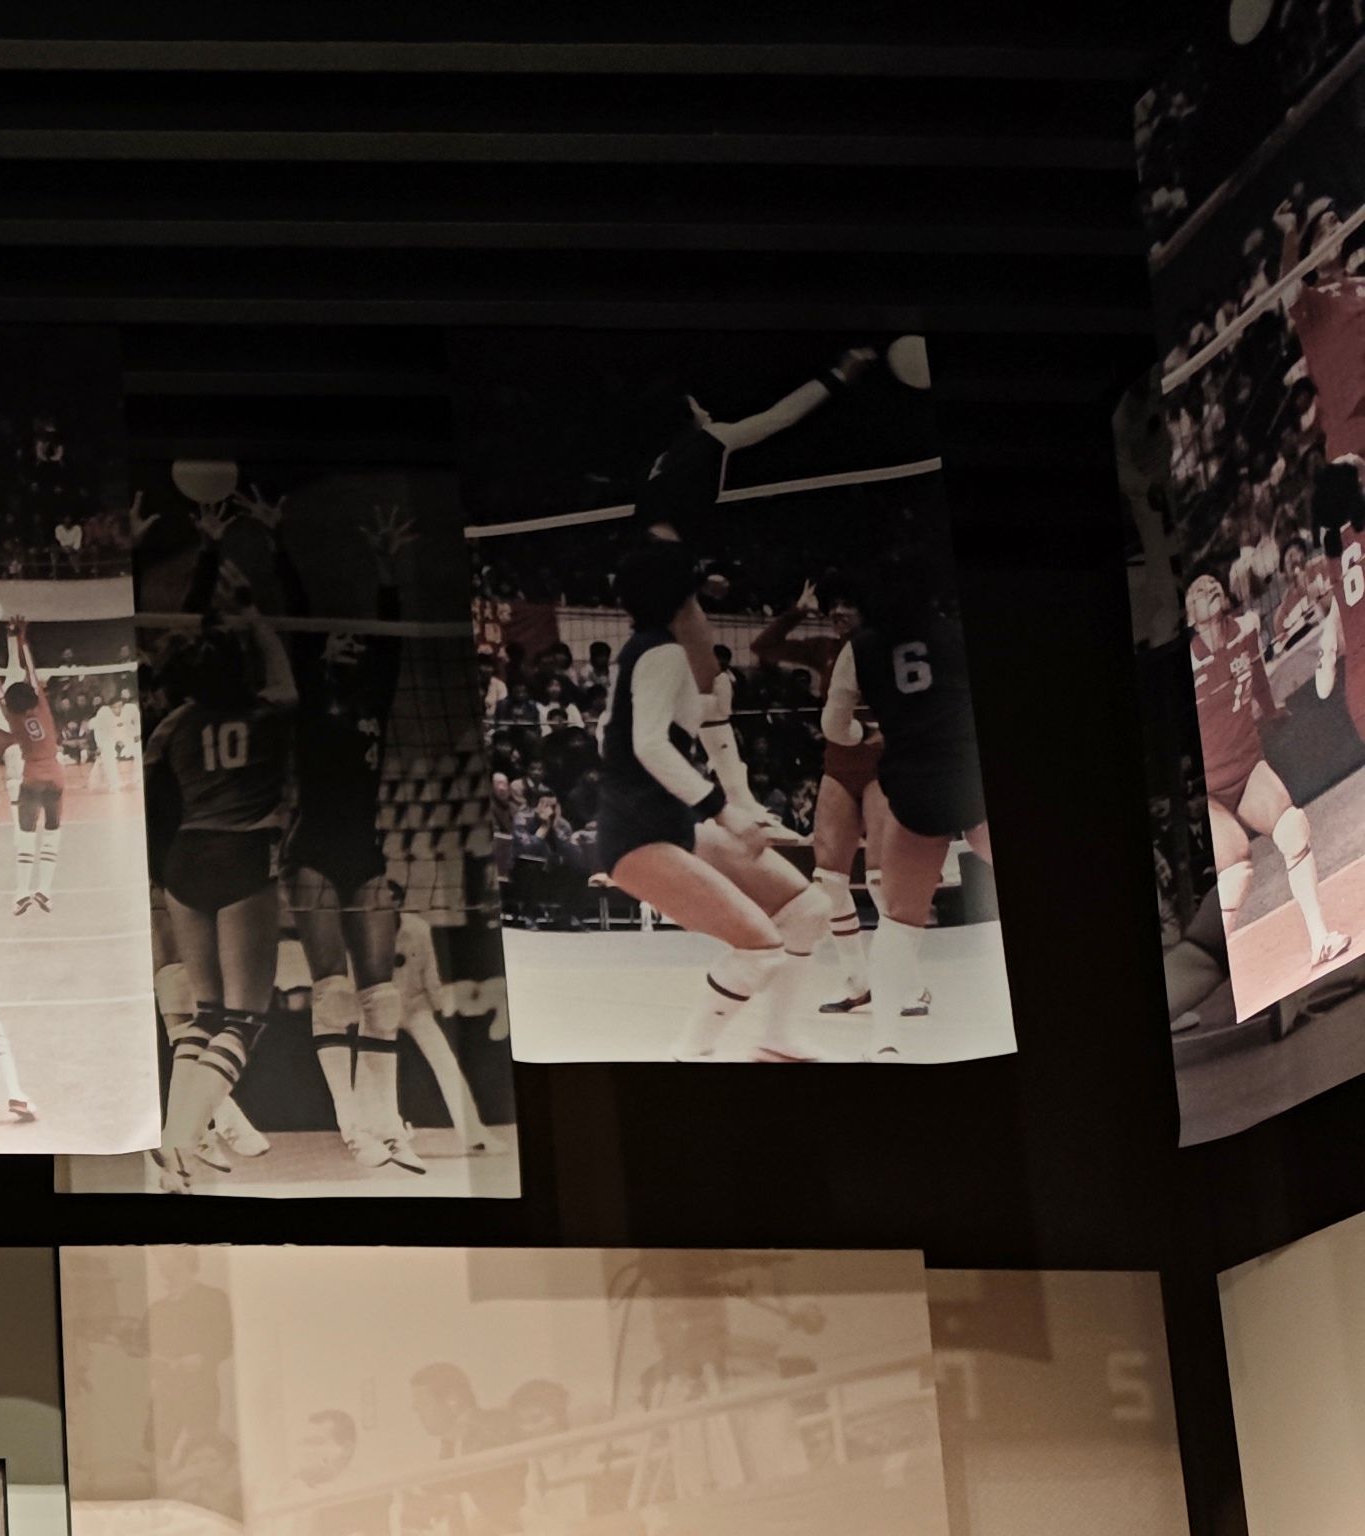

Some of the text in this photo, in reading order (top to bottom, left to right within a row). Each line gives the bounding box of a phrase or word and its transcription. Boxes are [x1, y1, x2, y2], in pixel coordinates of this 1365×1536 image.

[1341, 541, 1365, 607] 6
[891, 640, 934, 695] 6
[24, 716, 45, 742] 9
[200, 719, 251, 772] 10
